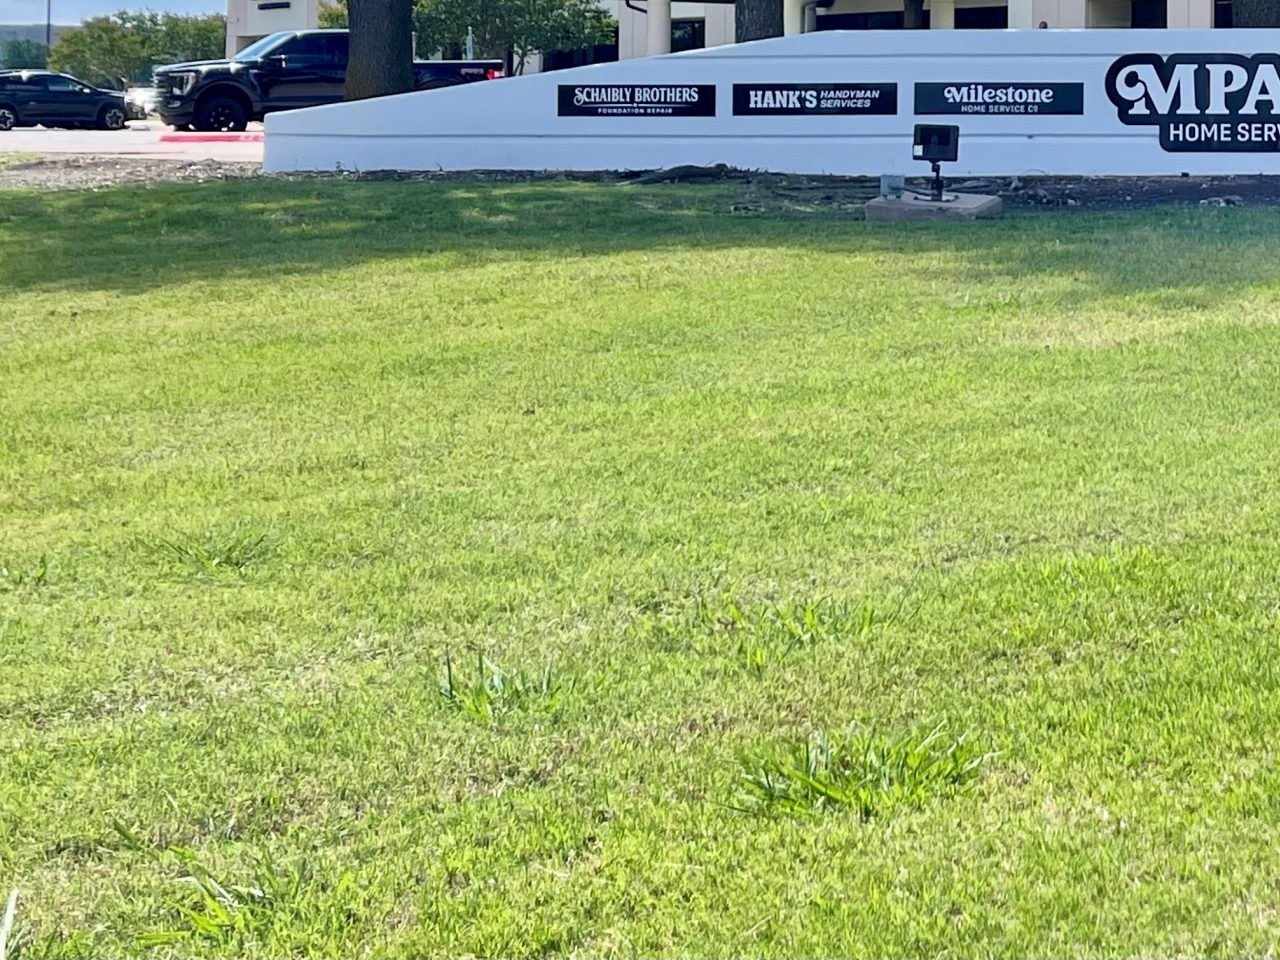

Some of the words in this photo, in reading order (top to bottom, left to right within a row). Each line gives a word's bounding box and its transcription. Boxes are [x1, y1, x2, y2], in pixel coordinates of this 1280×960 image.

[573, 87, 632, 106] SCHAIBLY
[634, 87, 699, 103] BROTHERS
[749, 90, 818, 109] HANK'S
[820, 90, 880, 99] HANDYMAN
[943, 84, 1054, 103] Milestone
[820, 99, 872, 108] SERVICES
[961, 105, 986, 113] HOME
[988, 105, 1026, 113] SERVICE
[1169, 123, 1232, 142] HOME
